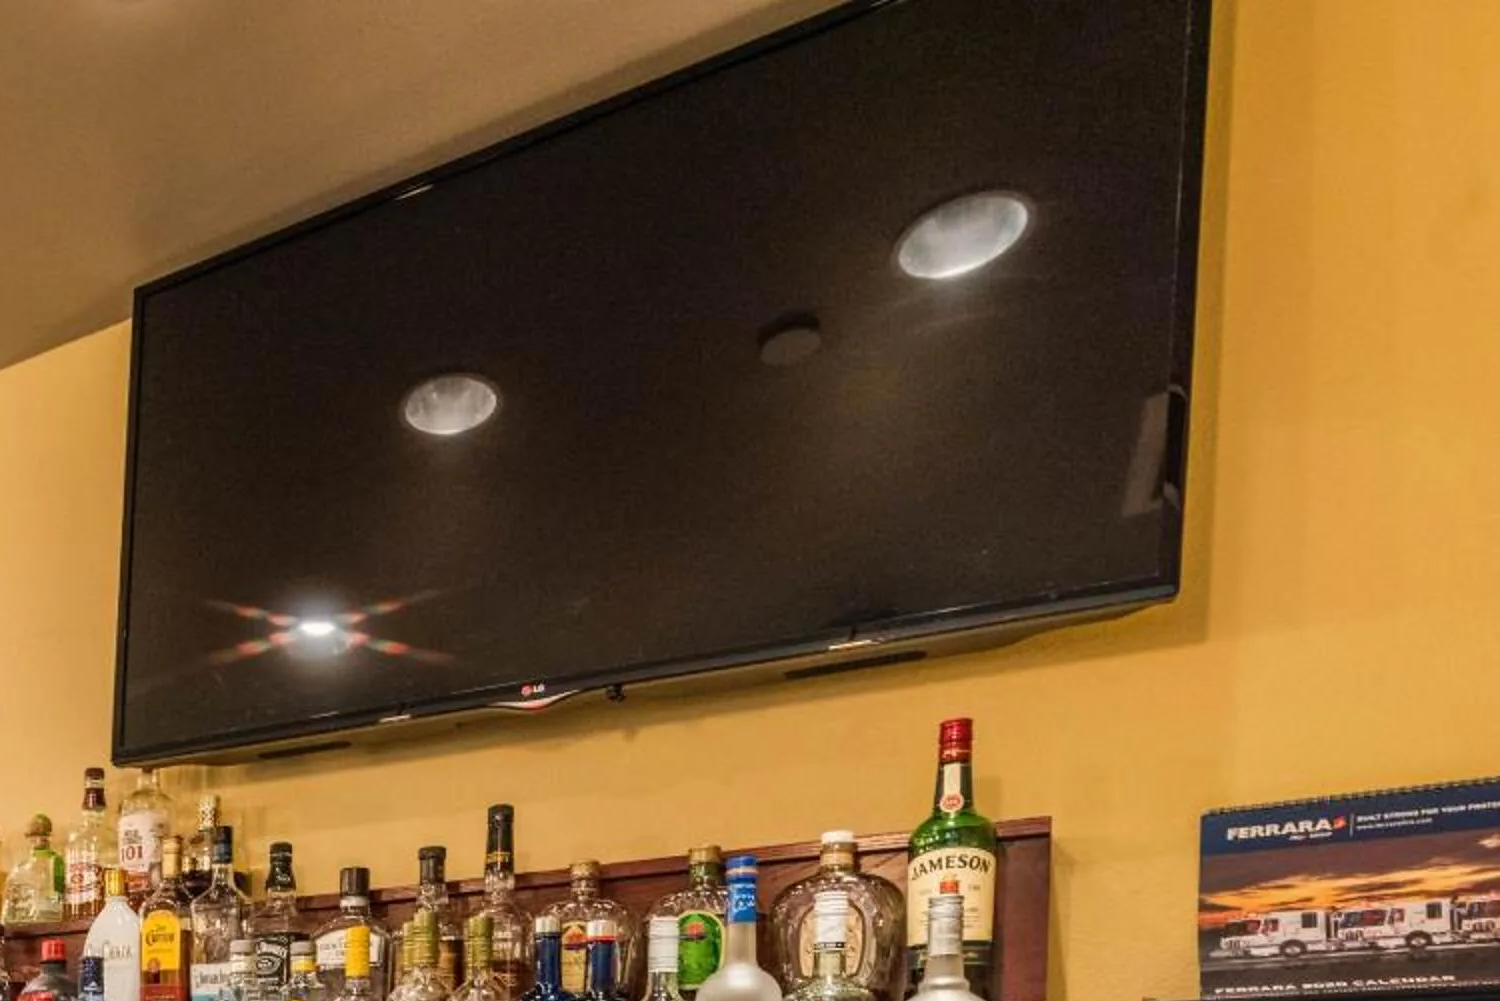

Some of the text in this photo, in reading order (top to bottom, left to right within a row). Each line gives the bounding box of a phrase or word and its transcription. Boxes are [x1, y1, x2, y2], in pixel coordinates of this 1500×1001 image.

[1226, 818, 1333, 841] FERRARA
[910, 853, 992, 881] JAMESON
[1214, 983, 1298, 995] FERRARA
[1351, 974, 1456, 988] CALENDAR
